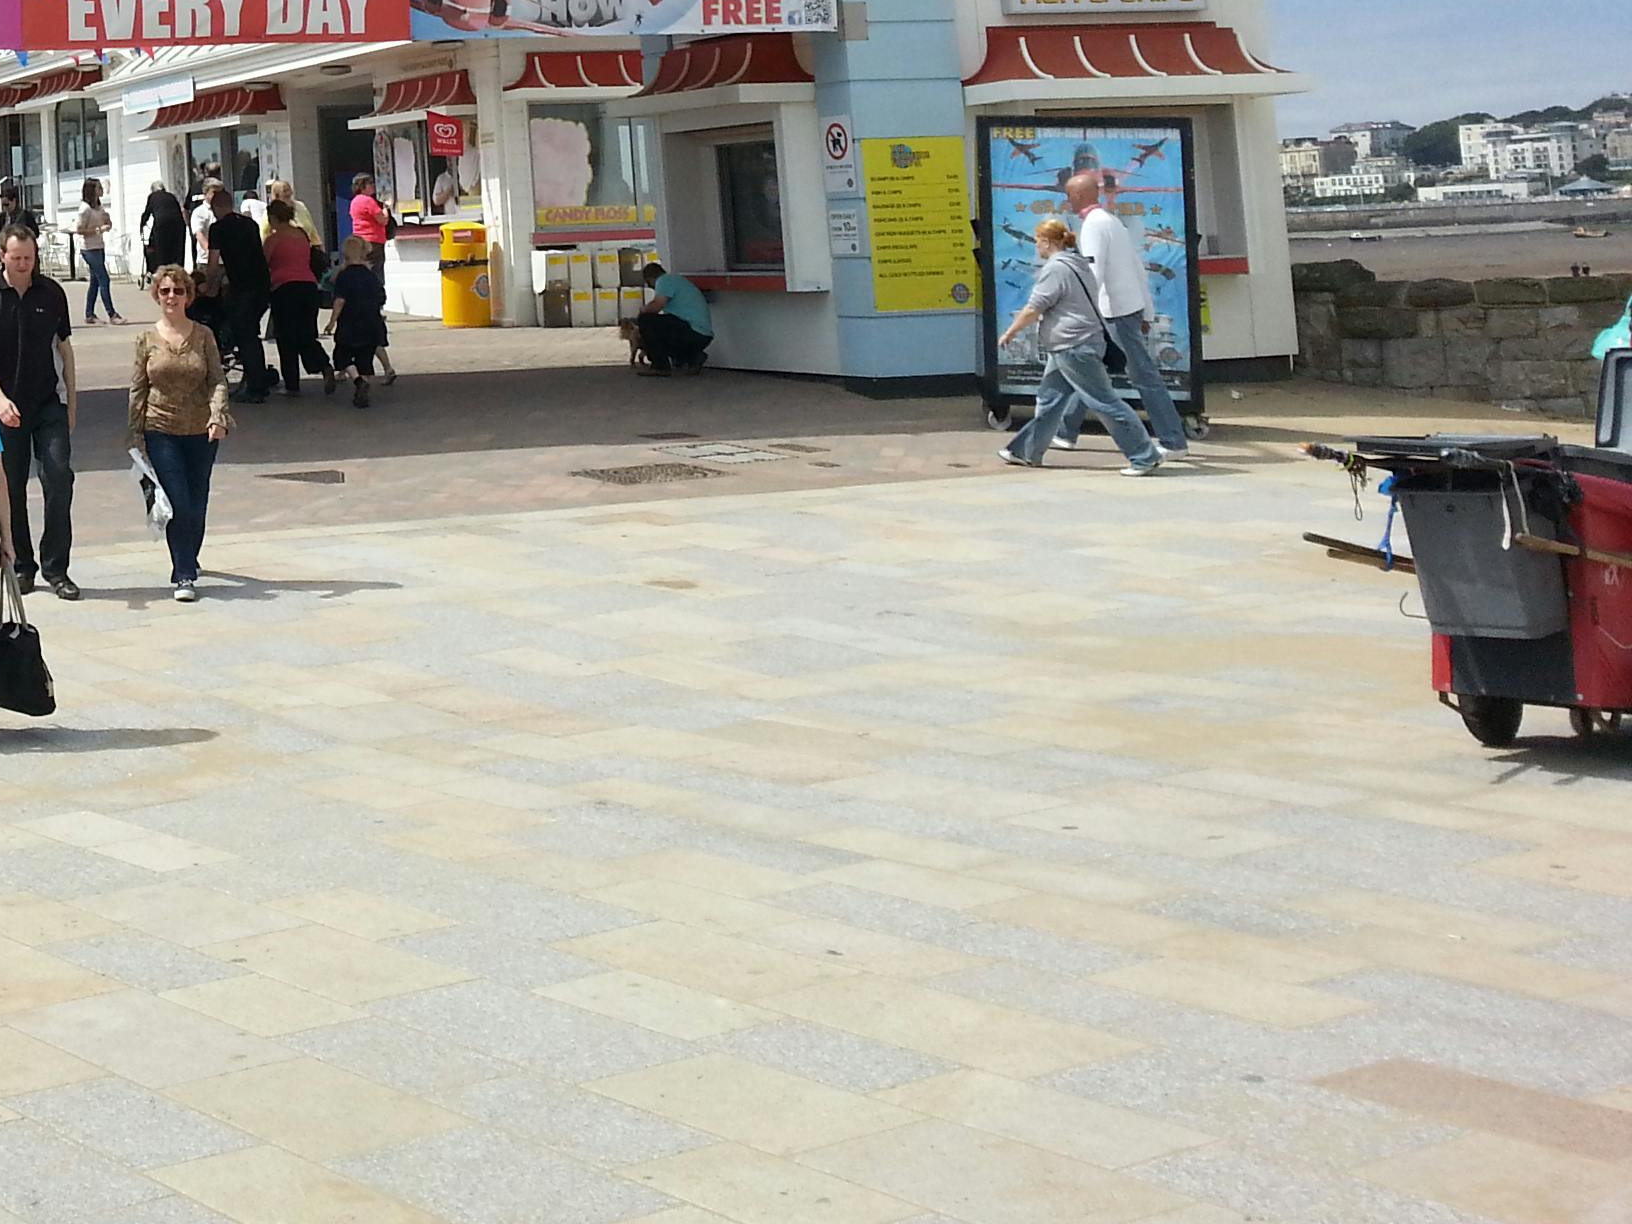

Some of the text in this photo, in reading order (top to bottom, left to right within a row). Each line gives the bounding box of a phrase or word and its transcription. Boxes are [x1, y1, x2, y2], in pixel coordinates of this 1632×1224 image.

[992, 127, 1036, 139] FREE
[545, 207, 631, 221] CANDY FLOSS
